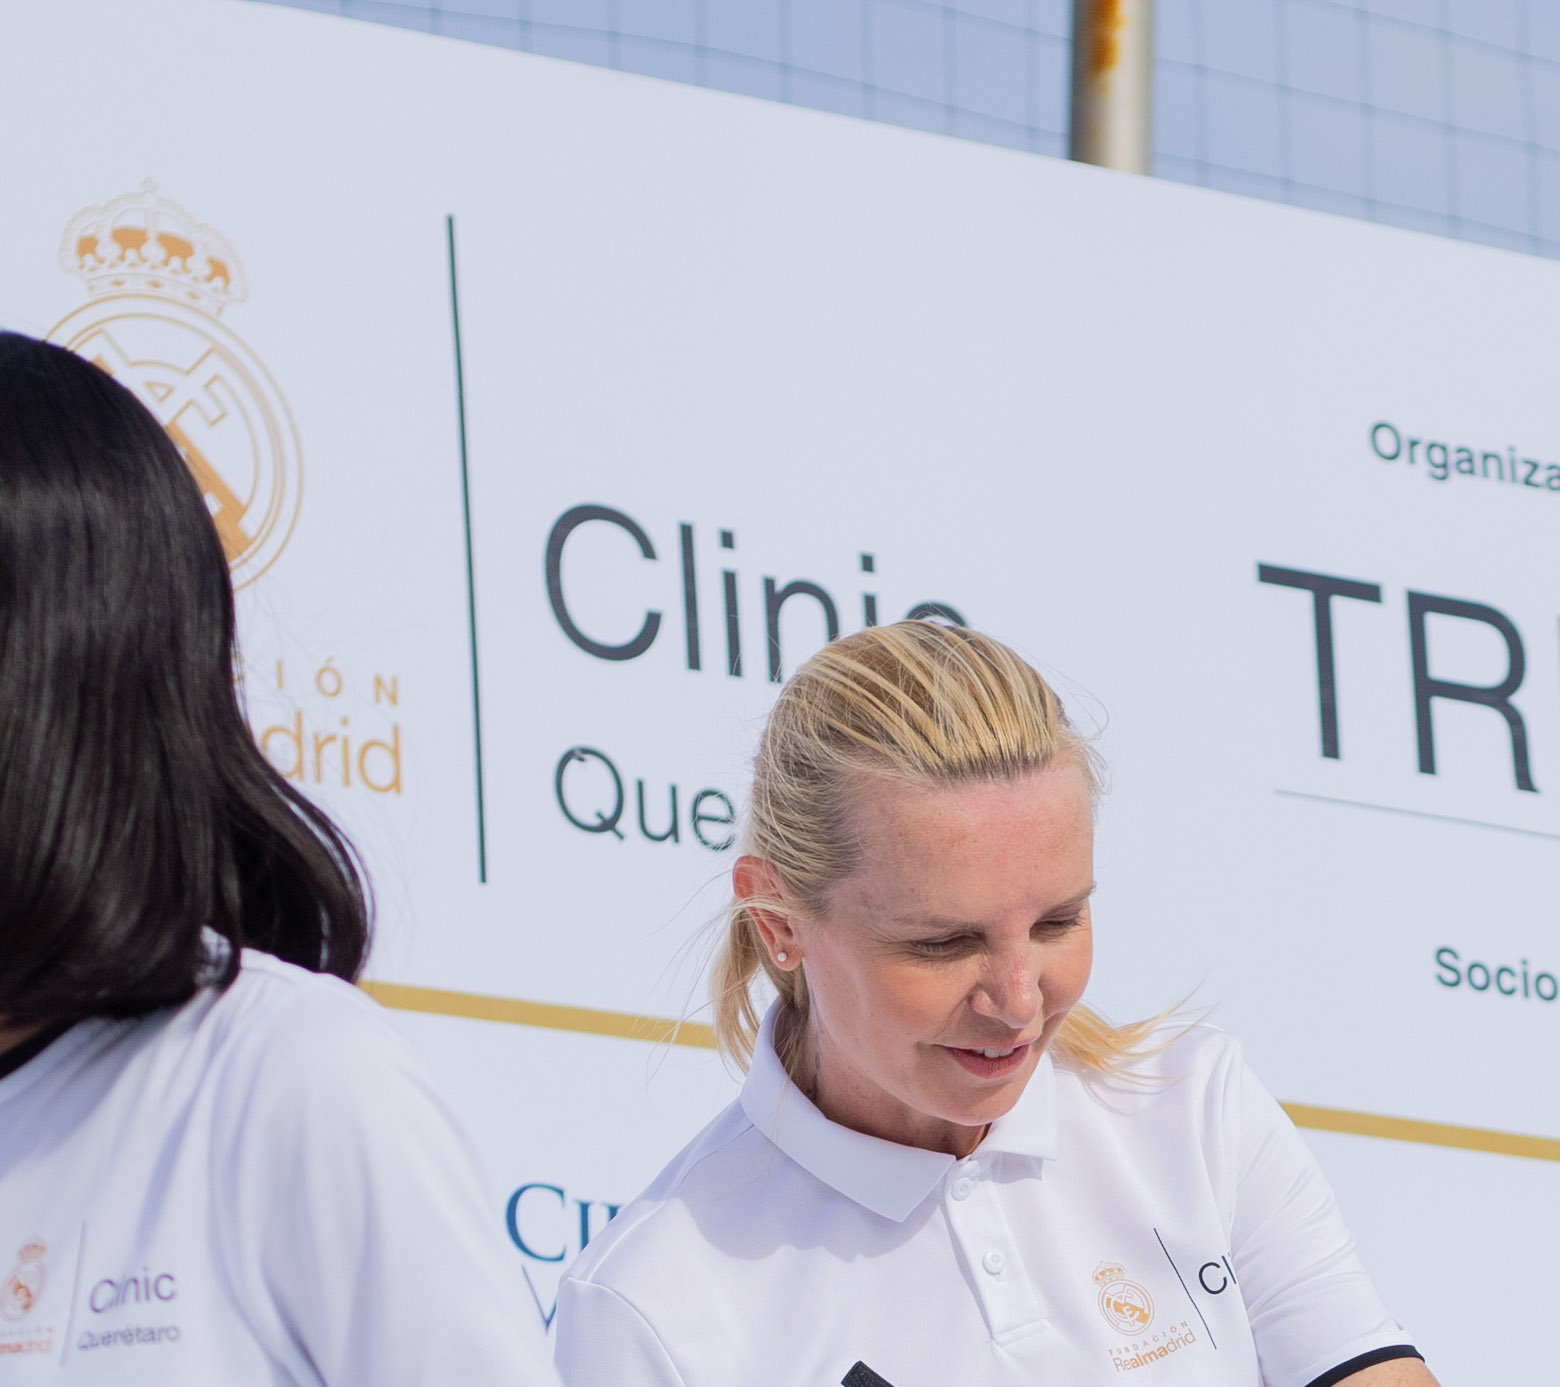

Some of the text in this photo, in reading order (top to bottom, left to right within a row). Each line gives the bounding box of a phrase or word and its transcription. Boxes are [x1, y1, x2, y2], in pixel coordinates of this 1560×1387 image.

[542, 502, 969, 684] Clin
[1435, 948, 1559, 1003] Socio
[1113, 1328, 1197, 1372] Realmadrid
